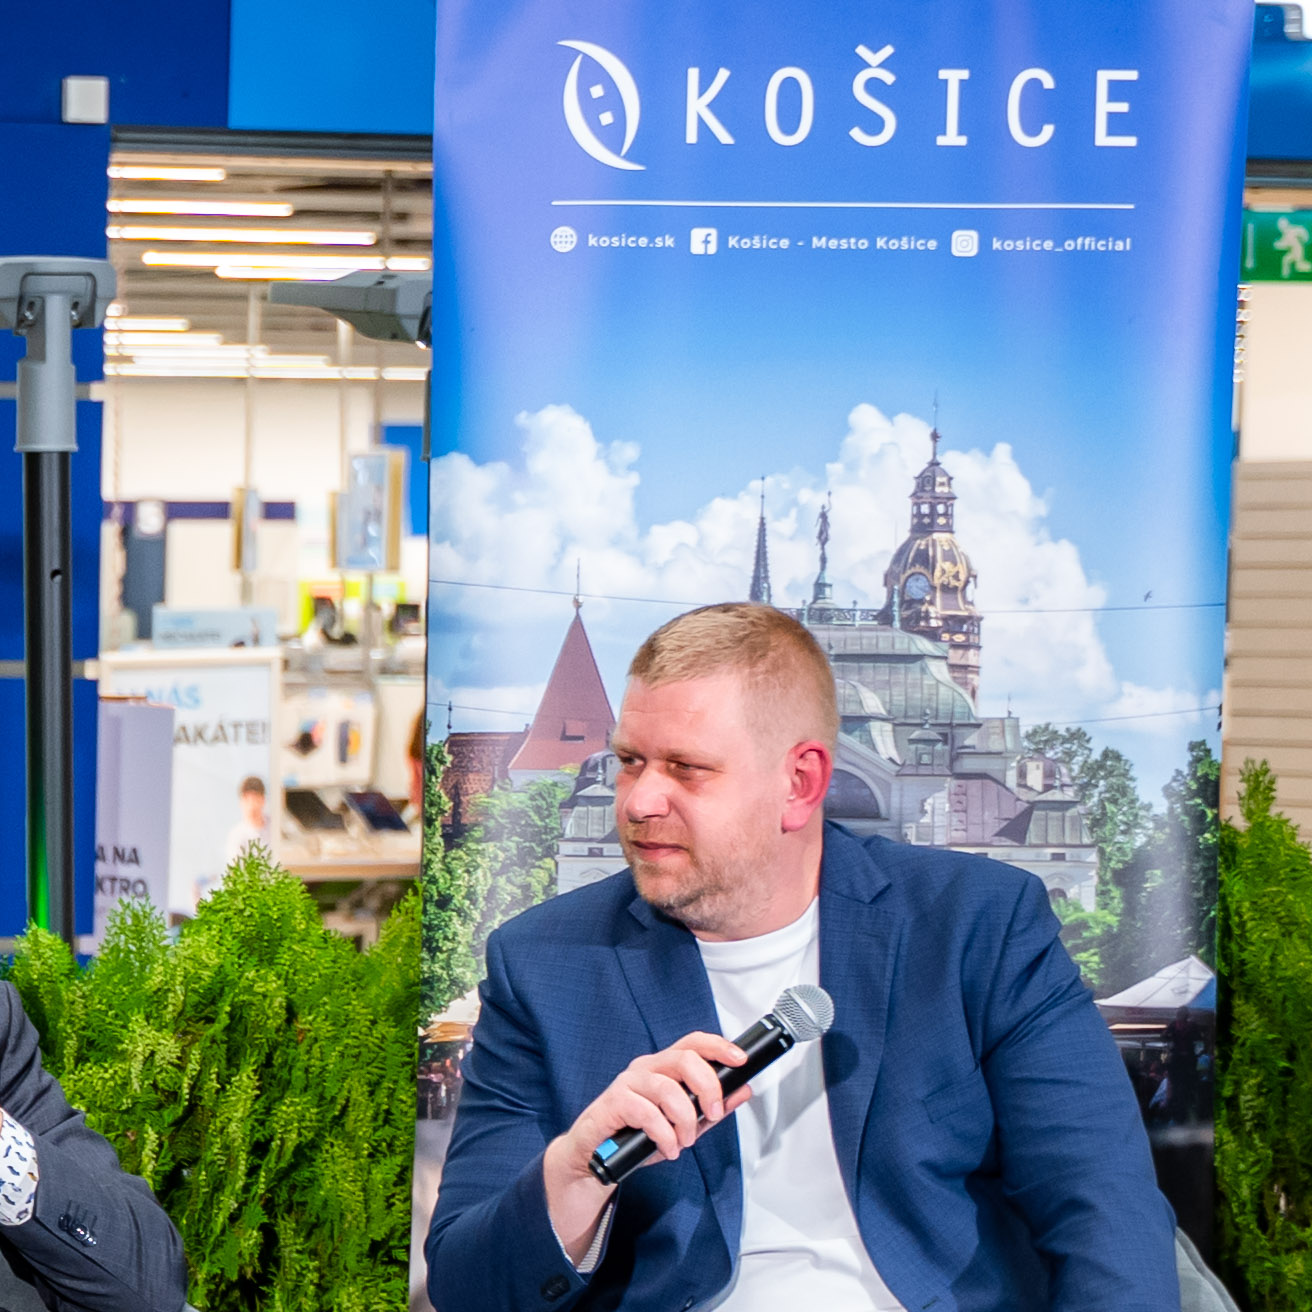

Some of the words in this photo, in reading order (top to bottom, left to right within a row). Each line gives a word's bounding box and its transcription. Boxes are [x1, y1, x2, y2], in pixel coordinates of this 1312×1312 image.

[685, 44, 1139, 148] KOŠICE
[588, 232, 675, 249] kosice.sk
[727, 234, 790, 250] Košice
[811, 235, 869, 251] Mesto
[876, 235, 938, 251] Košice
[992, 235, 1131, 253] kosice_official
[113, 846, 141, 866] NA
